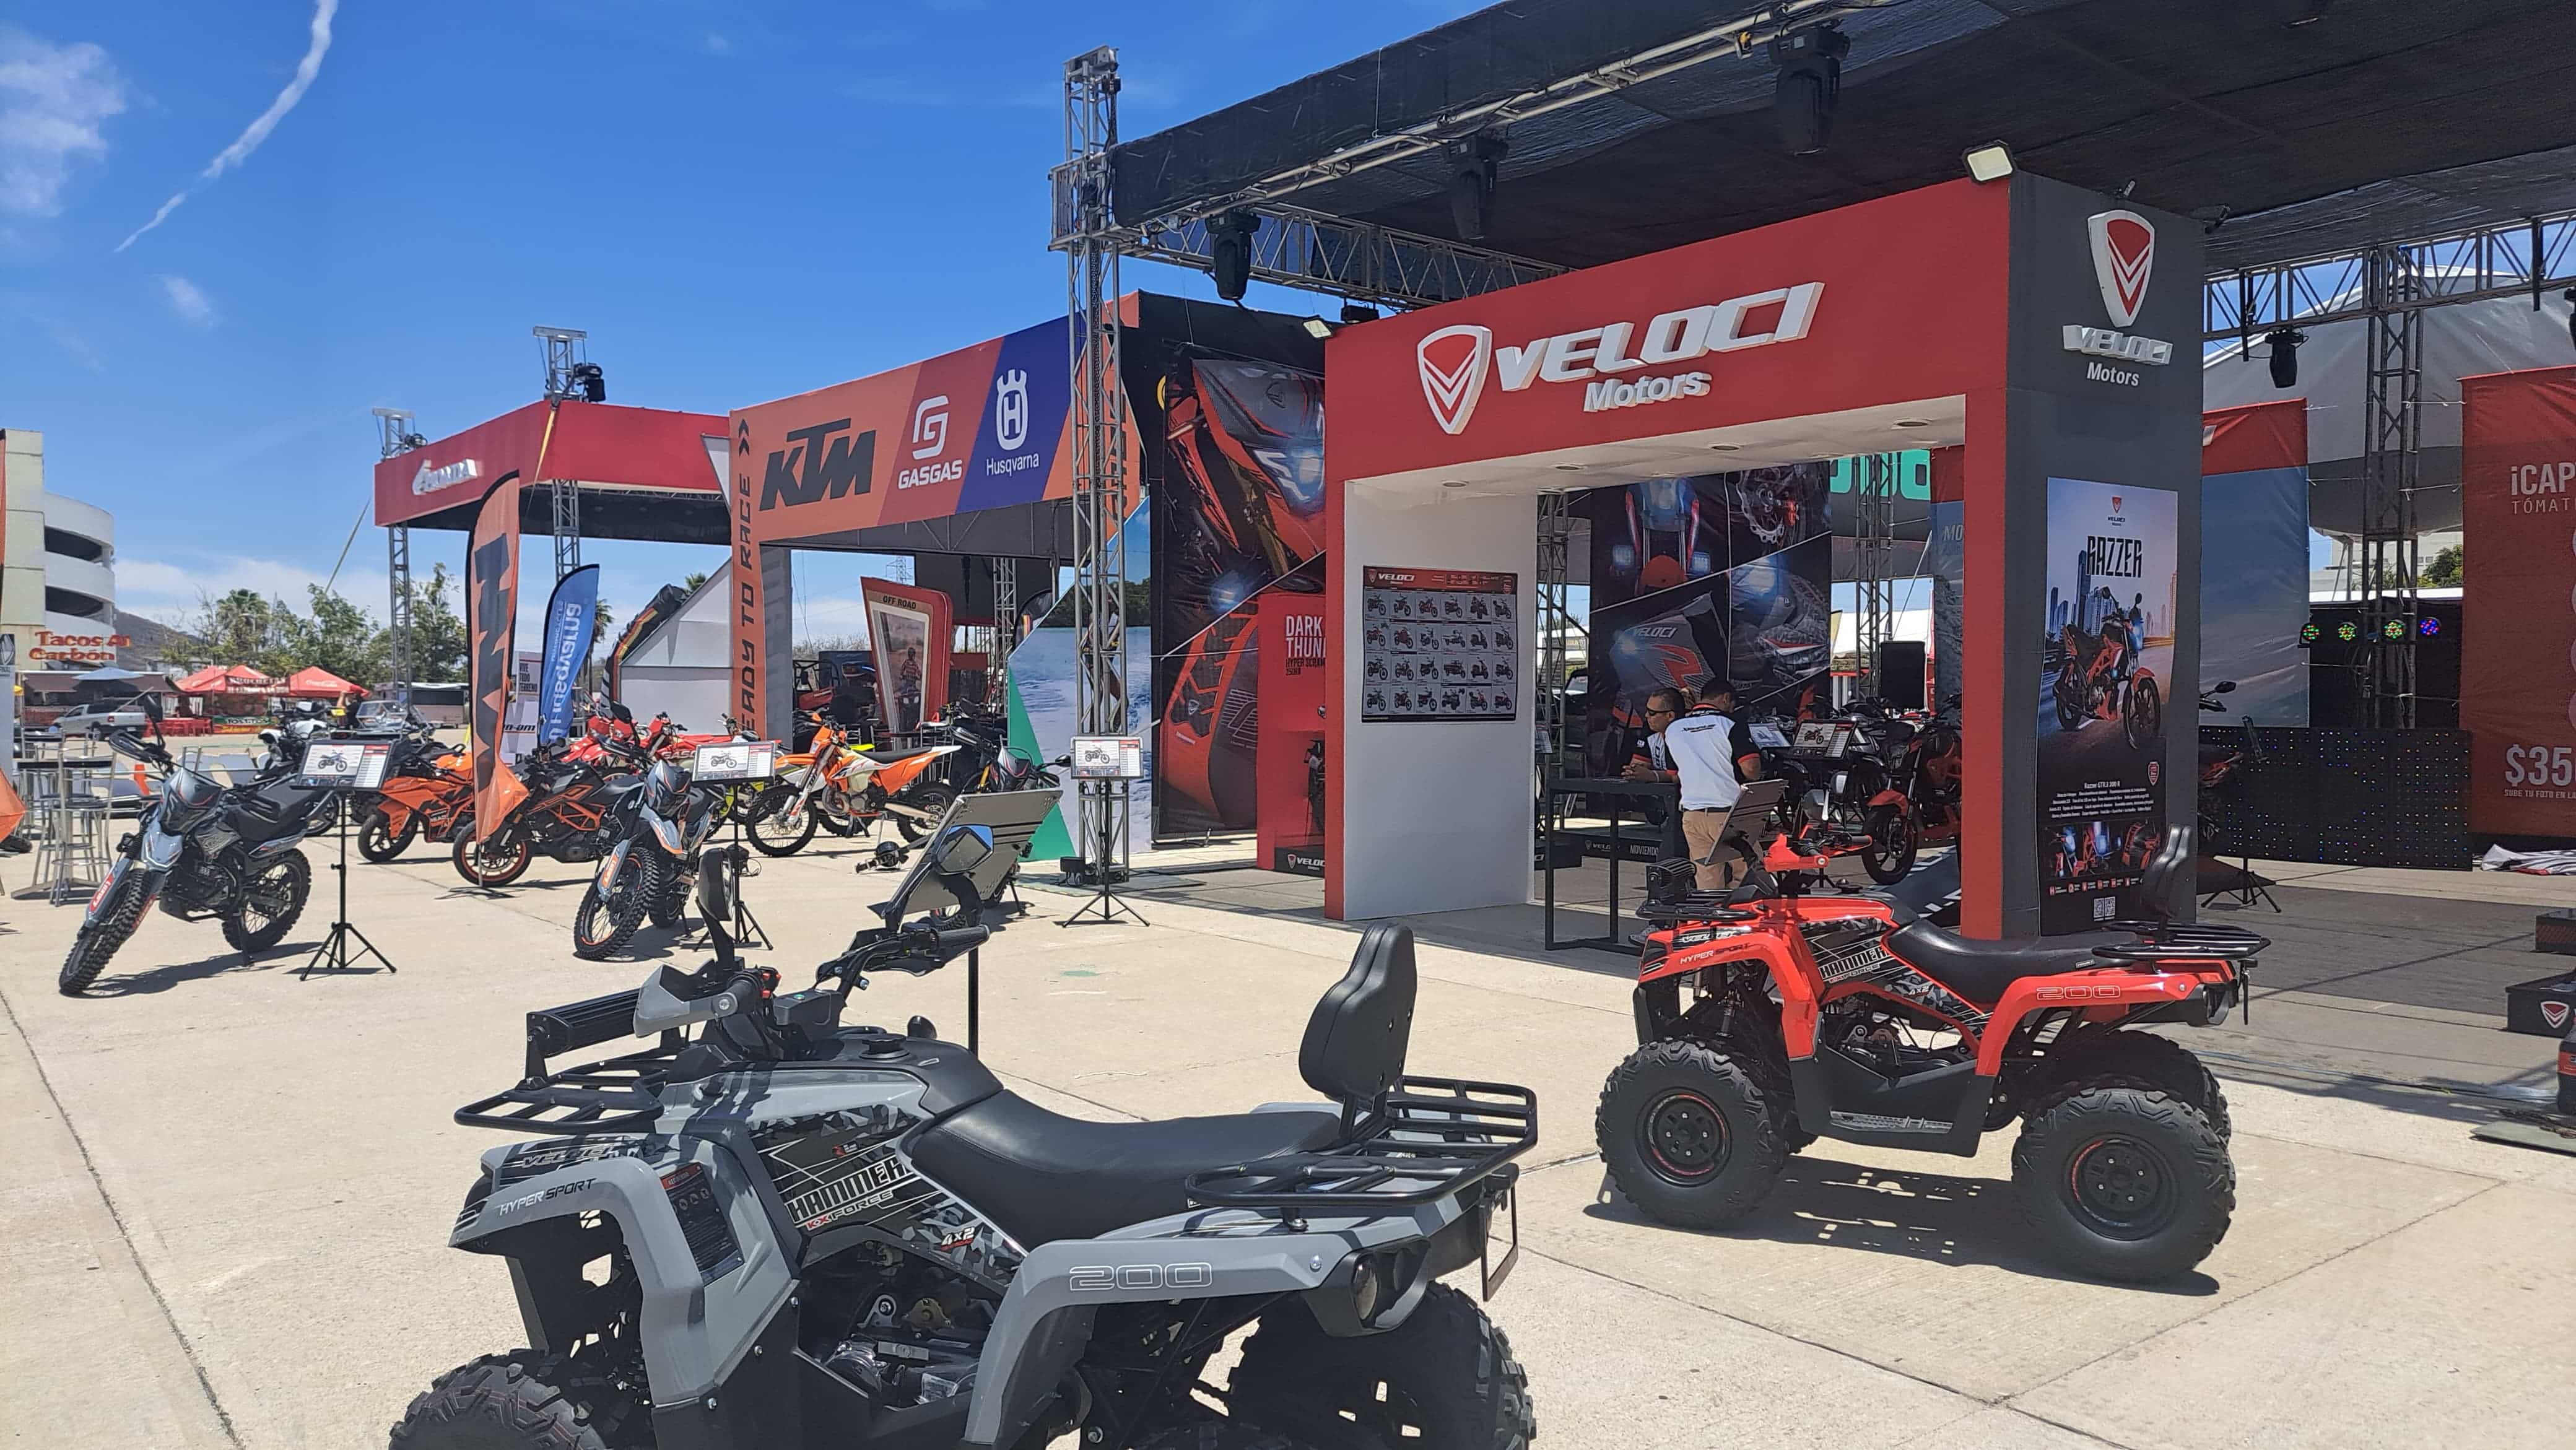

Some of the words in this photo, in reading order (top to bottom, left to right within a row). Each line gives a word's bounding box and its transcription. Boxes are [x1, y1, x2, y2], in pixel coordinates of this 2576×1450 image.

[1496, 282, 1825, 391] VELOCI
[2086, 362, 2140, 387] Motors
[1583, 371, 1713, 412] Motors
[759, 418, 876, 511] KTM
[898, 459, 963, 489] GASGAS
[986, 453, 1040, 477] Husqvarna
[2511, 462, 2576, 496] iCAP
[739, 475, 752, 571] RACE
[2086, 535, 2143, 578] RAZZER
[1378, 573, 1415, 581] VELOCI
[741, 584, 755, 627] TO
[882, 596, 896, 604] OFF
[898, 599, 916, 610] ROAD
[35, 631, 104, 646] Tacos
[107, 635, 131, 648] Al
[1286, 615, 1323, 637] DARK
[1634, 627, 1677, 638] VELOCI
[742, 641, 756, 736] EADY
[2505, 744, 2576, 786] $35
[1680, 950, 1714, 965] HYPER
[1818, 947, 1890, 979] HAMMER
[2037, 985, 2121, 1001] 200
[500, 1191, 545, 1217] HYPER
[545, 1178, 598, 1200] SPORT
[784, 1156, 910, 1225] HAMMER
[1069, 1262, 1212, 1292] 200
